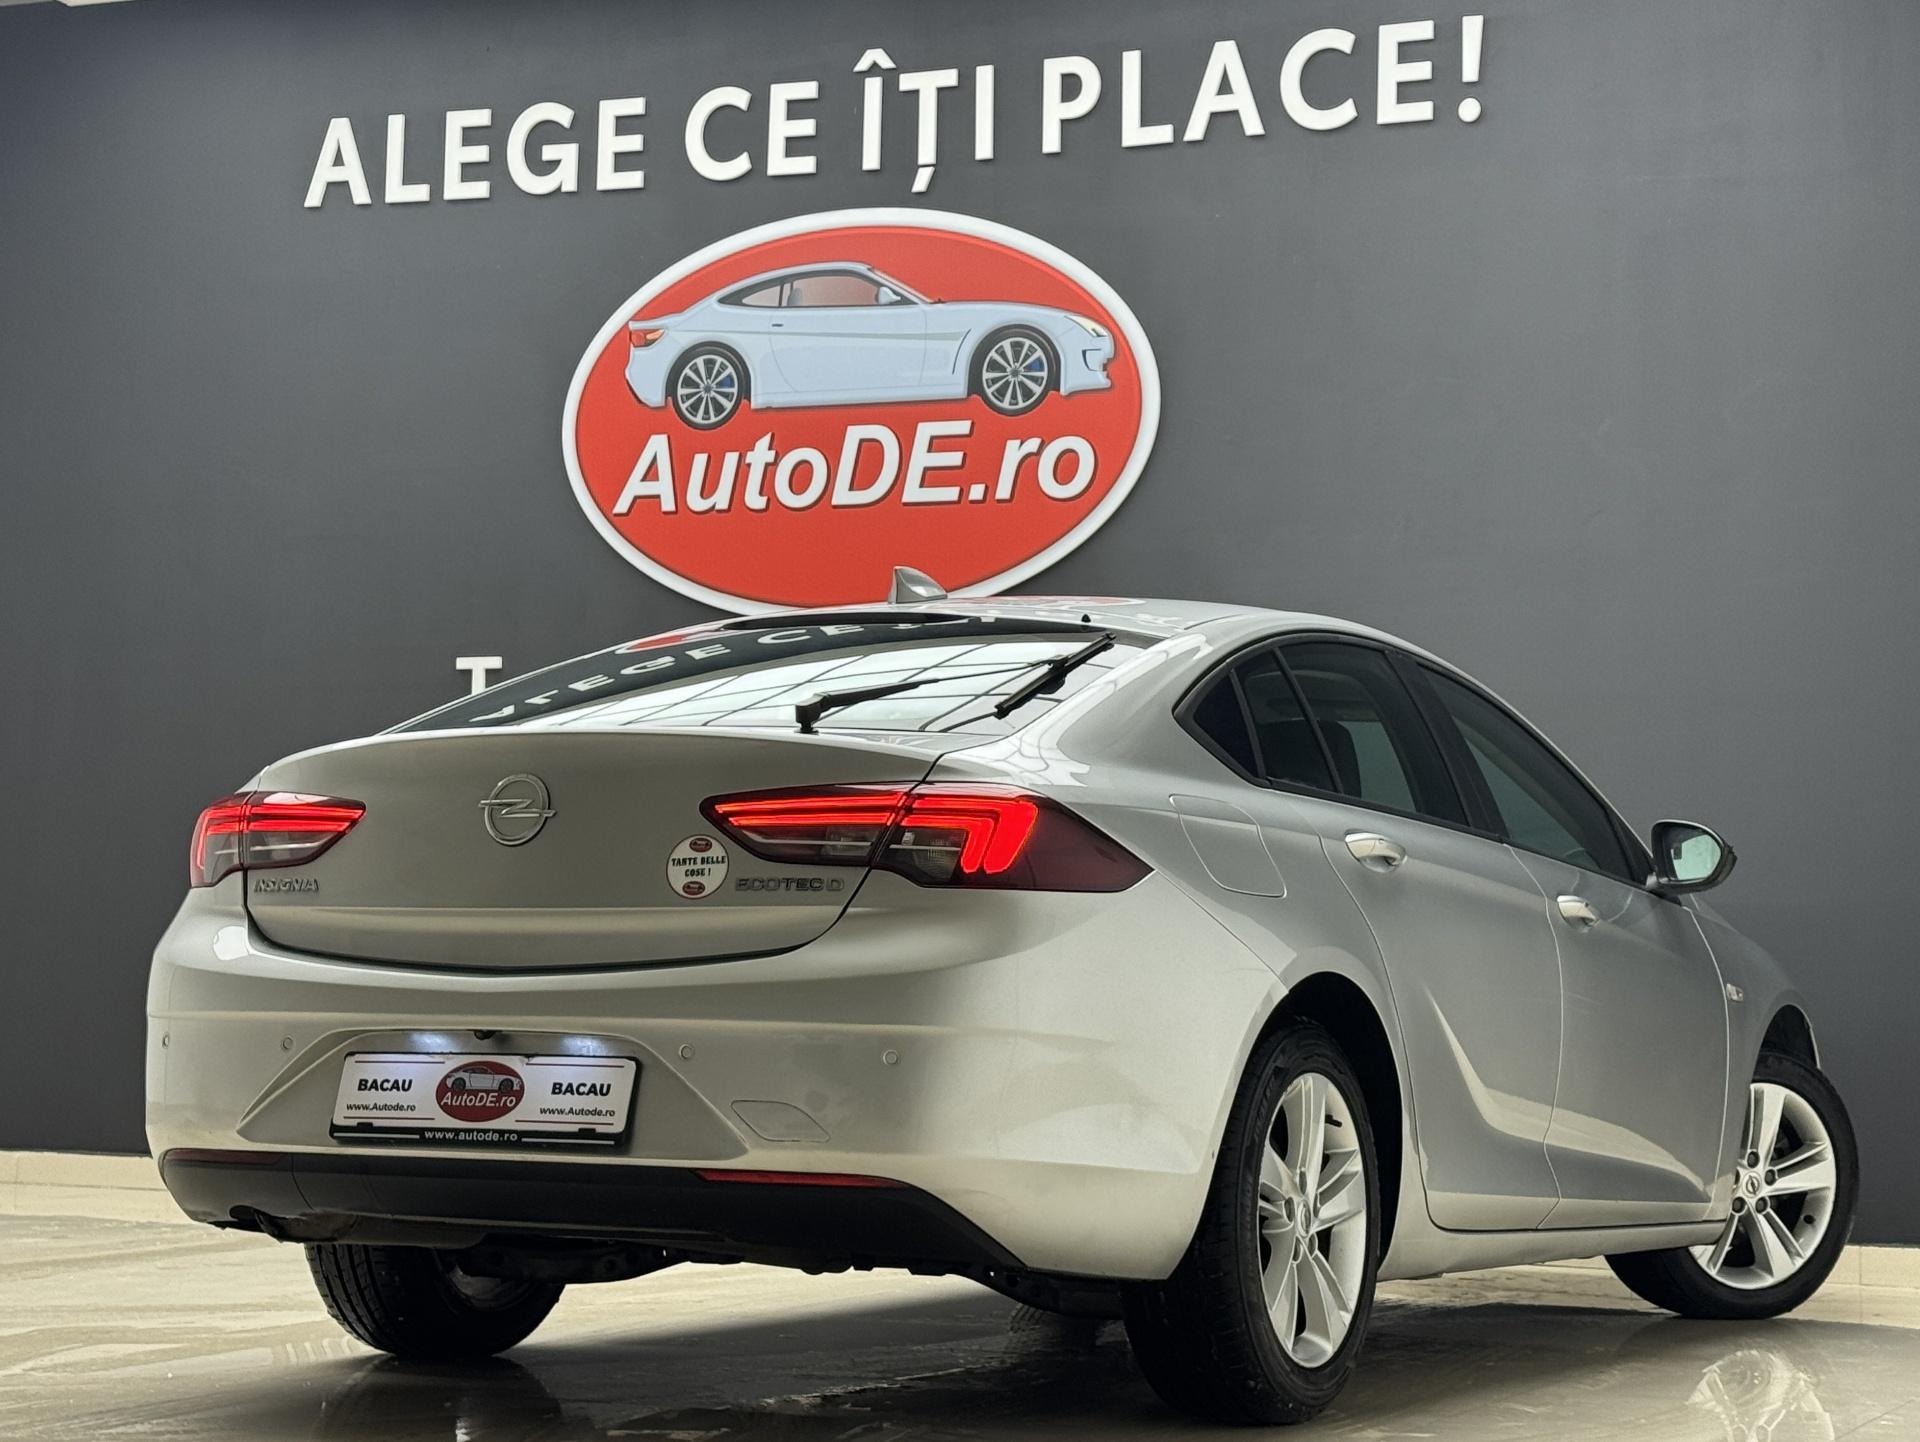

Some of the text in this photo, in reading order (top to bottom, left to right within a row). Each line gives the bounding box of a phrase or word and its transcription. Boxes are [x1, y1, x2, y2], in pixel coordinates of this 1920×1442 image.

[303, 97, 646, 208] ALEGE
[684, 80, 819, 182] CE
[1041, 14, 1484, 155] PLACE!
[612, 419, 1096, 516] AutoDE.ro
[671, 855, 726, 867] TANTE BELLE
[684, 868, 706, 877] COSE
[735, 877, 824, 891] ECOTEC
[357, 1078, 413, 1092] BACAU
[551, 1082, 611, 1097] BACAU
[440, 1091, 516, 1108] AutoDE.ro
[346, 1102, 416, 1112] www.Autode.ro
[539, 1106, 616, 1117] www.Autode.ro
[424, 1130, 518, 1142] www.autode.ro
